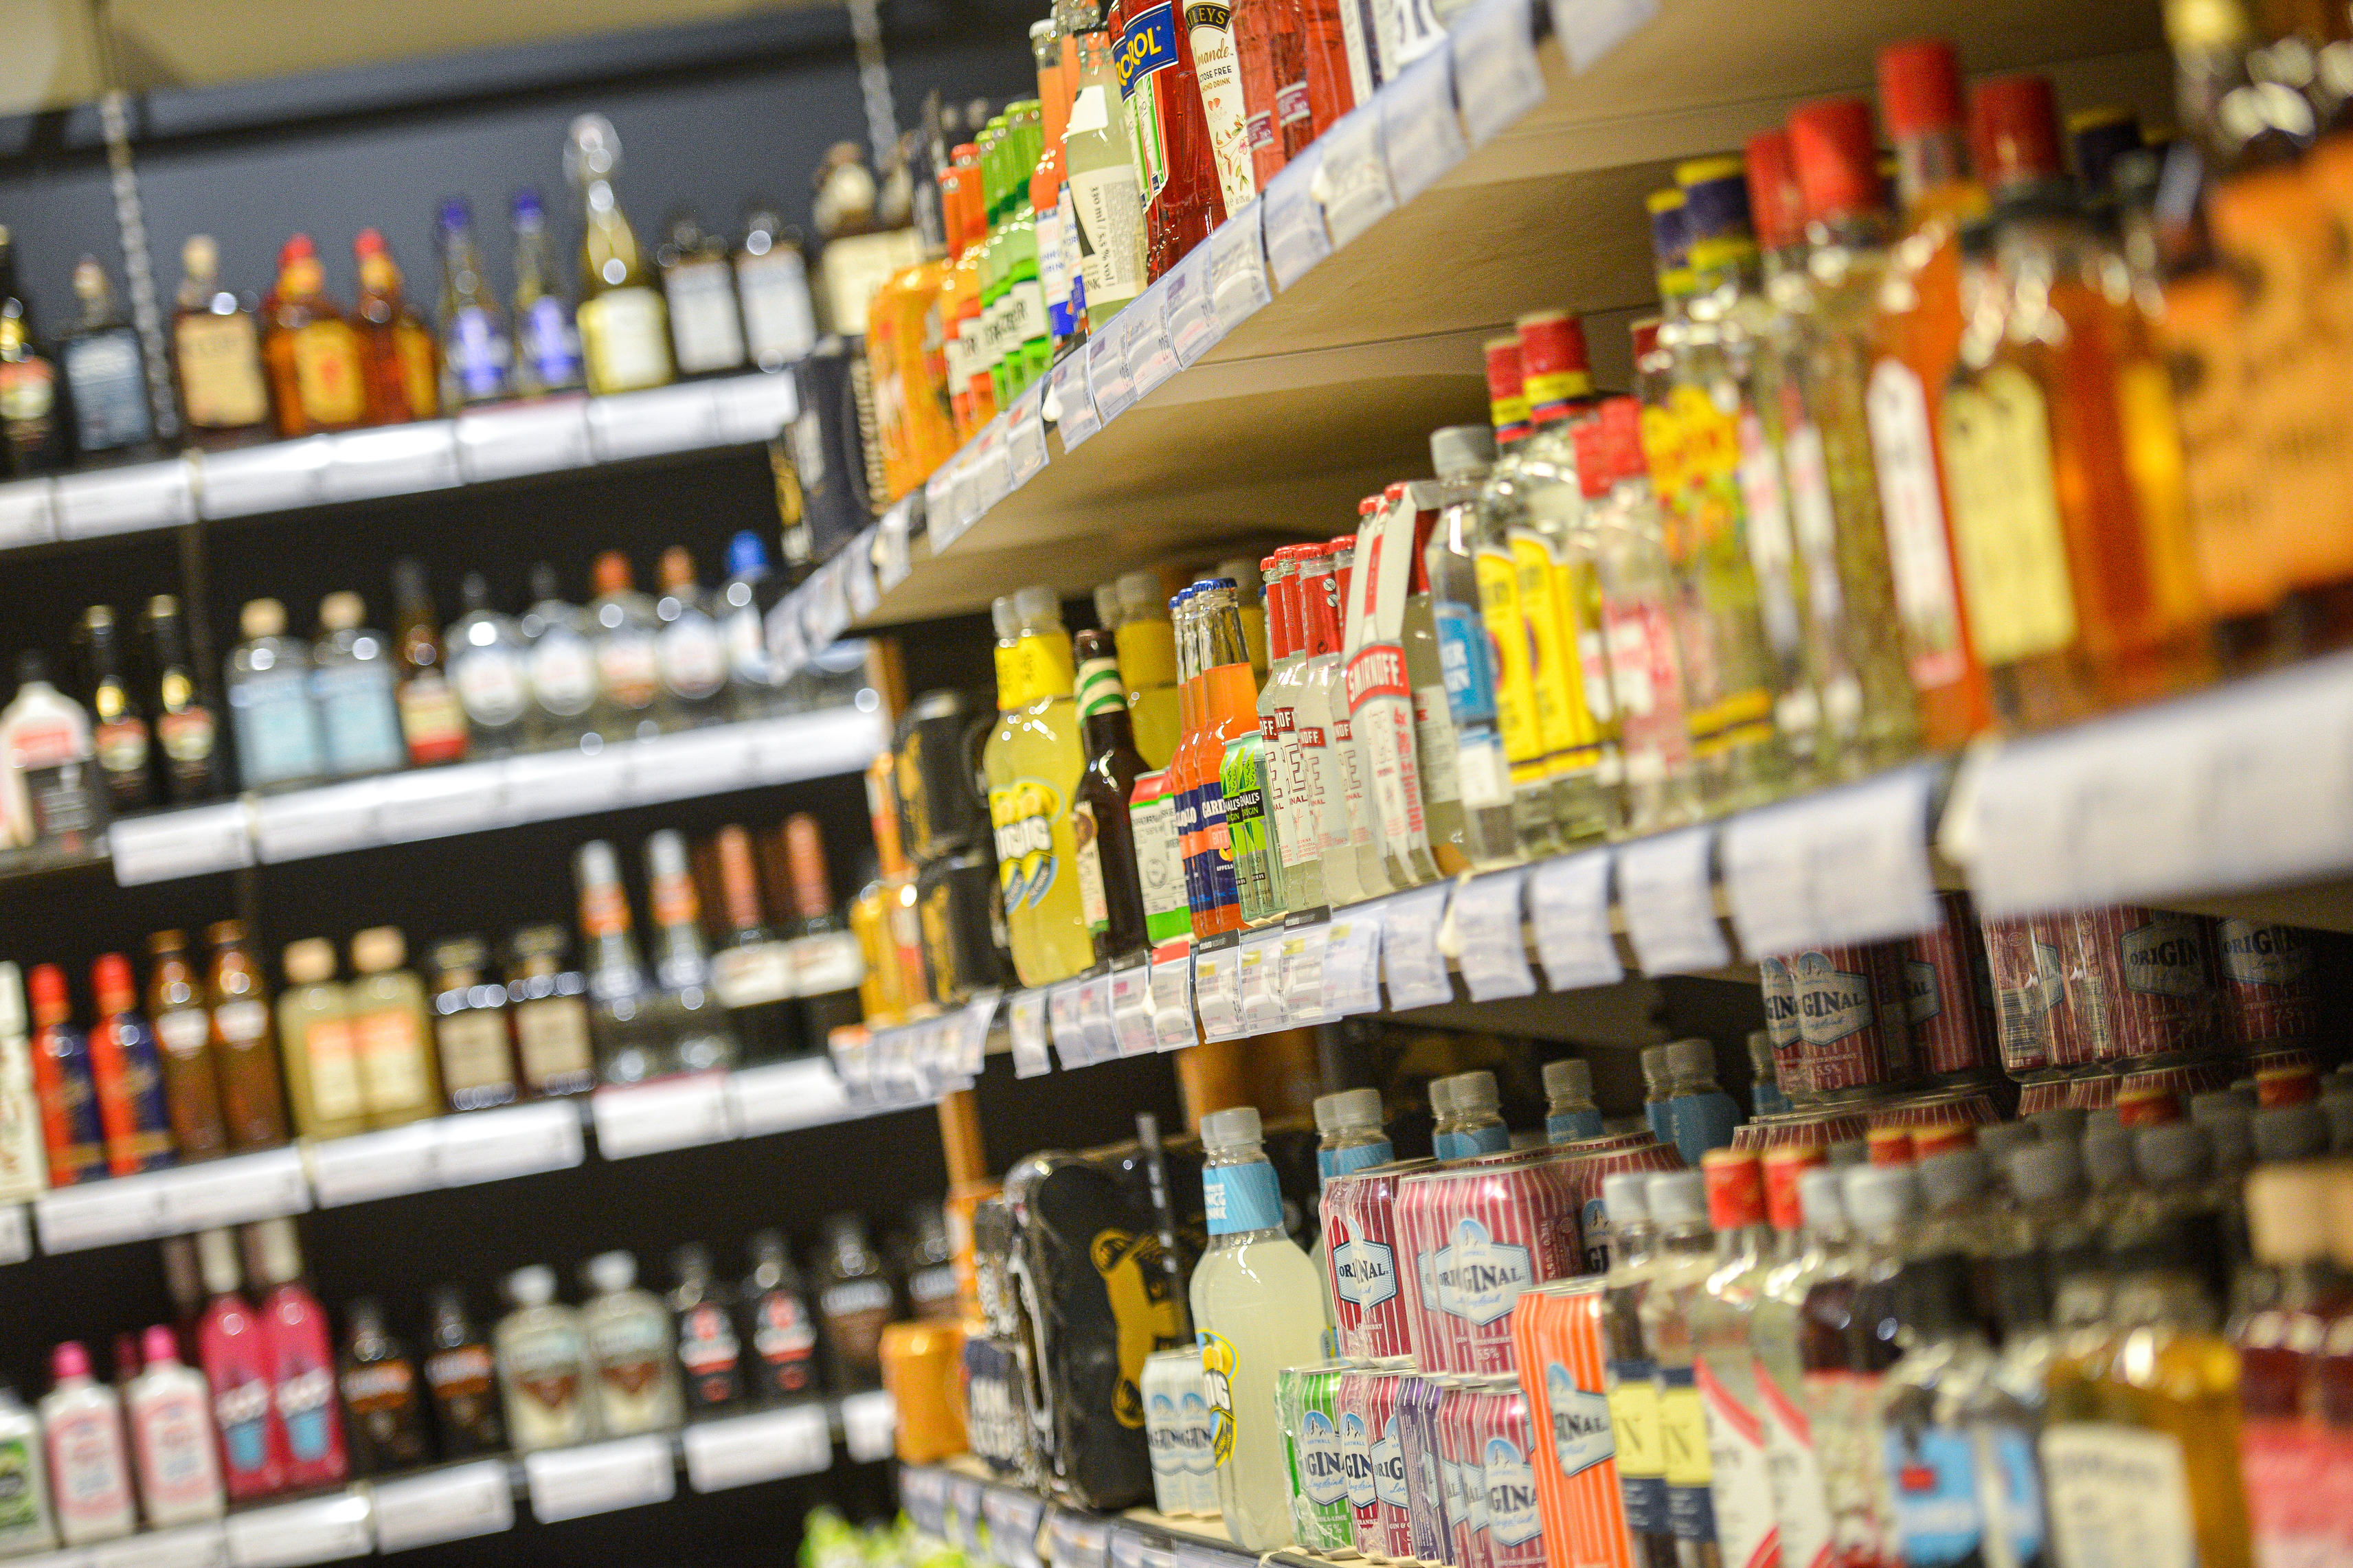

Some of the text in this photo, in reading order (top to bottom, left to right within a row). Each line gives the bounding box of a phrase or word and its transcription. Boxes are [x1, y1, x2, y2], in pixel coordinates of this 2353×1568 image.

[1213, 65, 1232, 77] FREE
[1213, 77, 1231, 88] DRINK
[1094, 207, 1106, 223] ml
